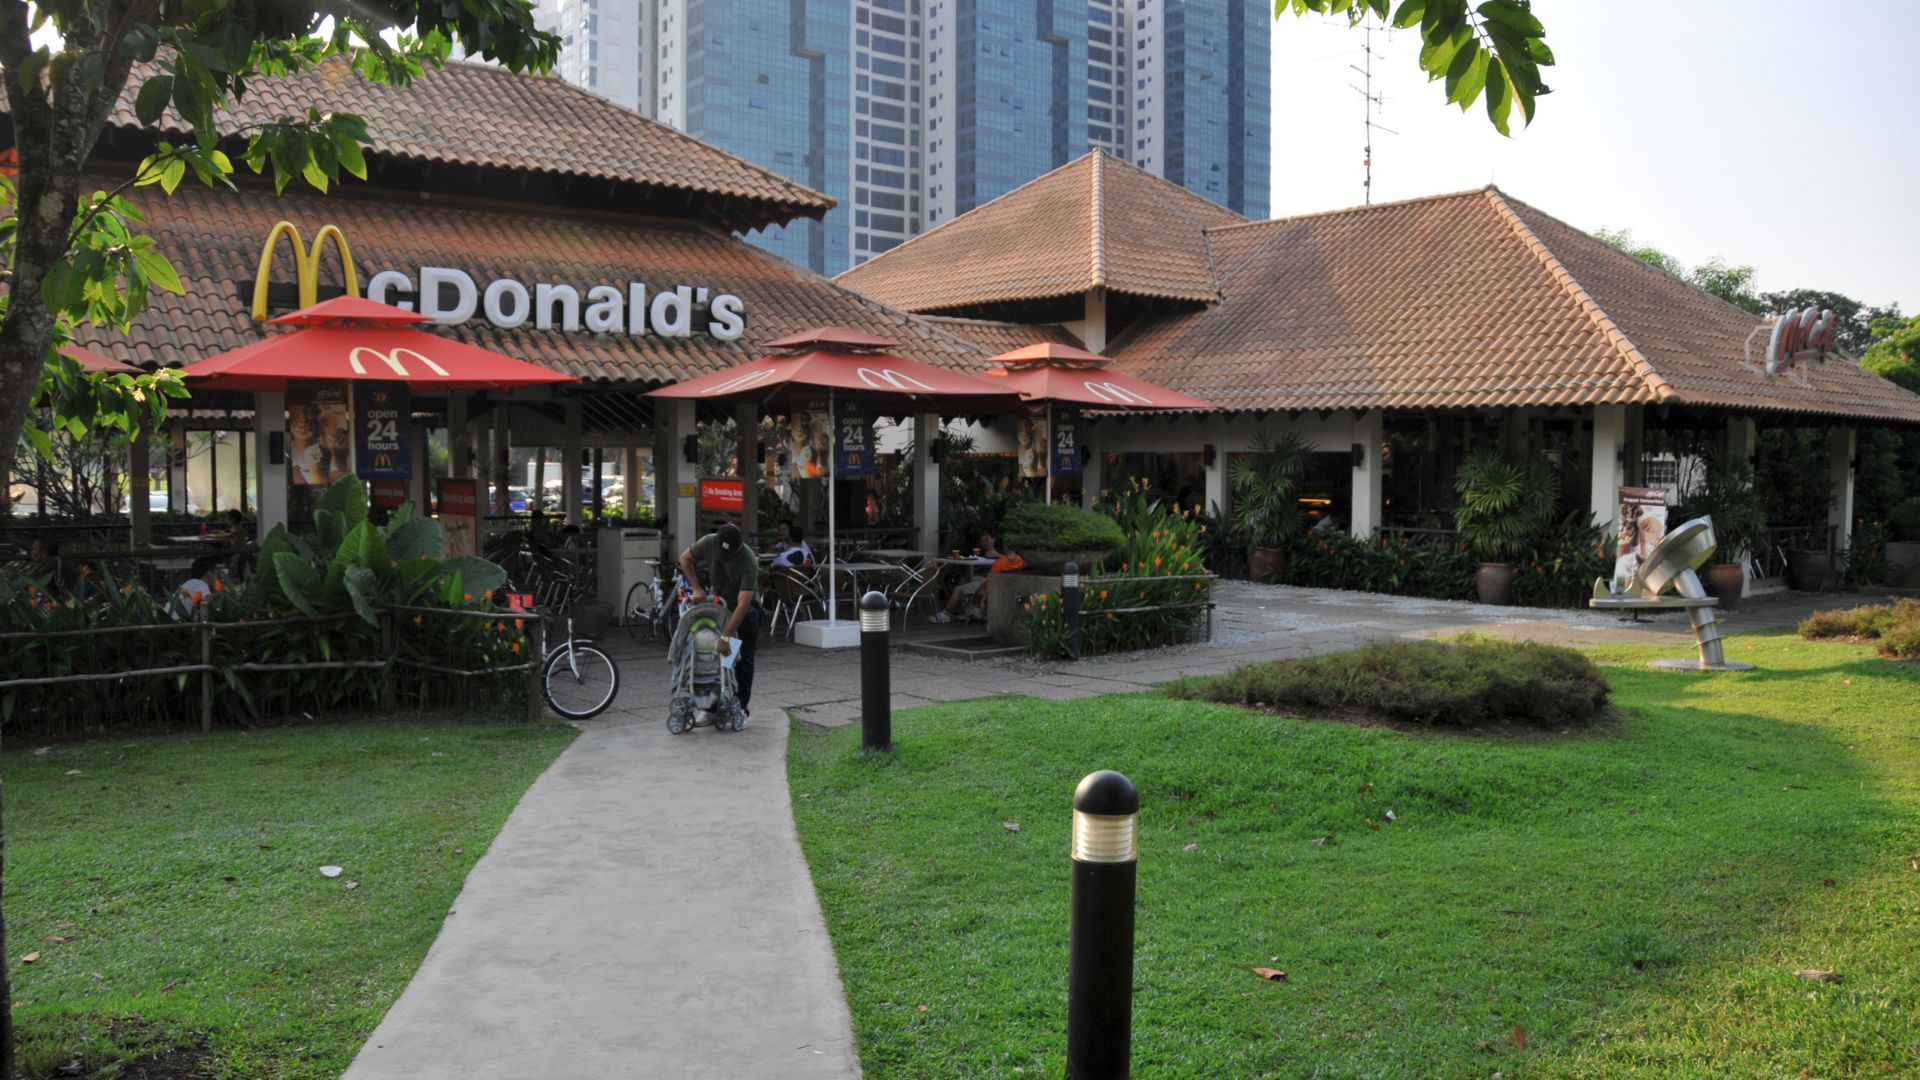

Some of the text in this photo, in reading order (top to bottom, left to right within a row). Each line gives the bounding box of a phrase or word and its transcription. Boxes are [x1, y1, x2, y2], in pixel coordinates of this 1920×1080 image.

[367, 409, 398, 421] open
[842, 417, 864, 426] open
[367, 420, 399, 441] 24
[1057, 424, 1074, 432] open
[843, 426, 864, 443] 24
[1057, 431, 1074, 447] 24
[368, 441, 399, 450] hours
[843, 443, 865, 451] hours
[714, 487, 732, 497] Smoking
